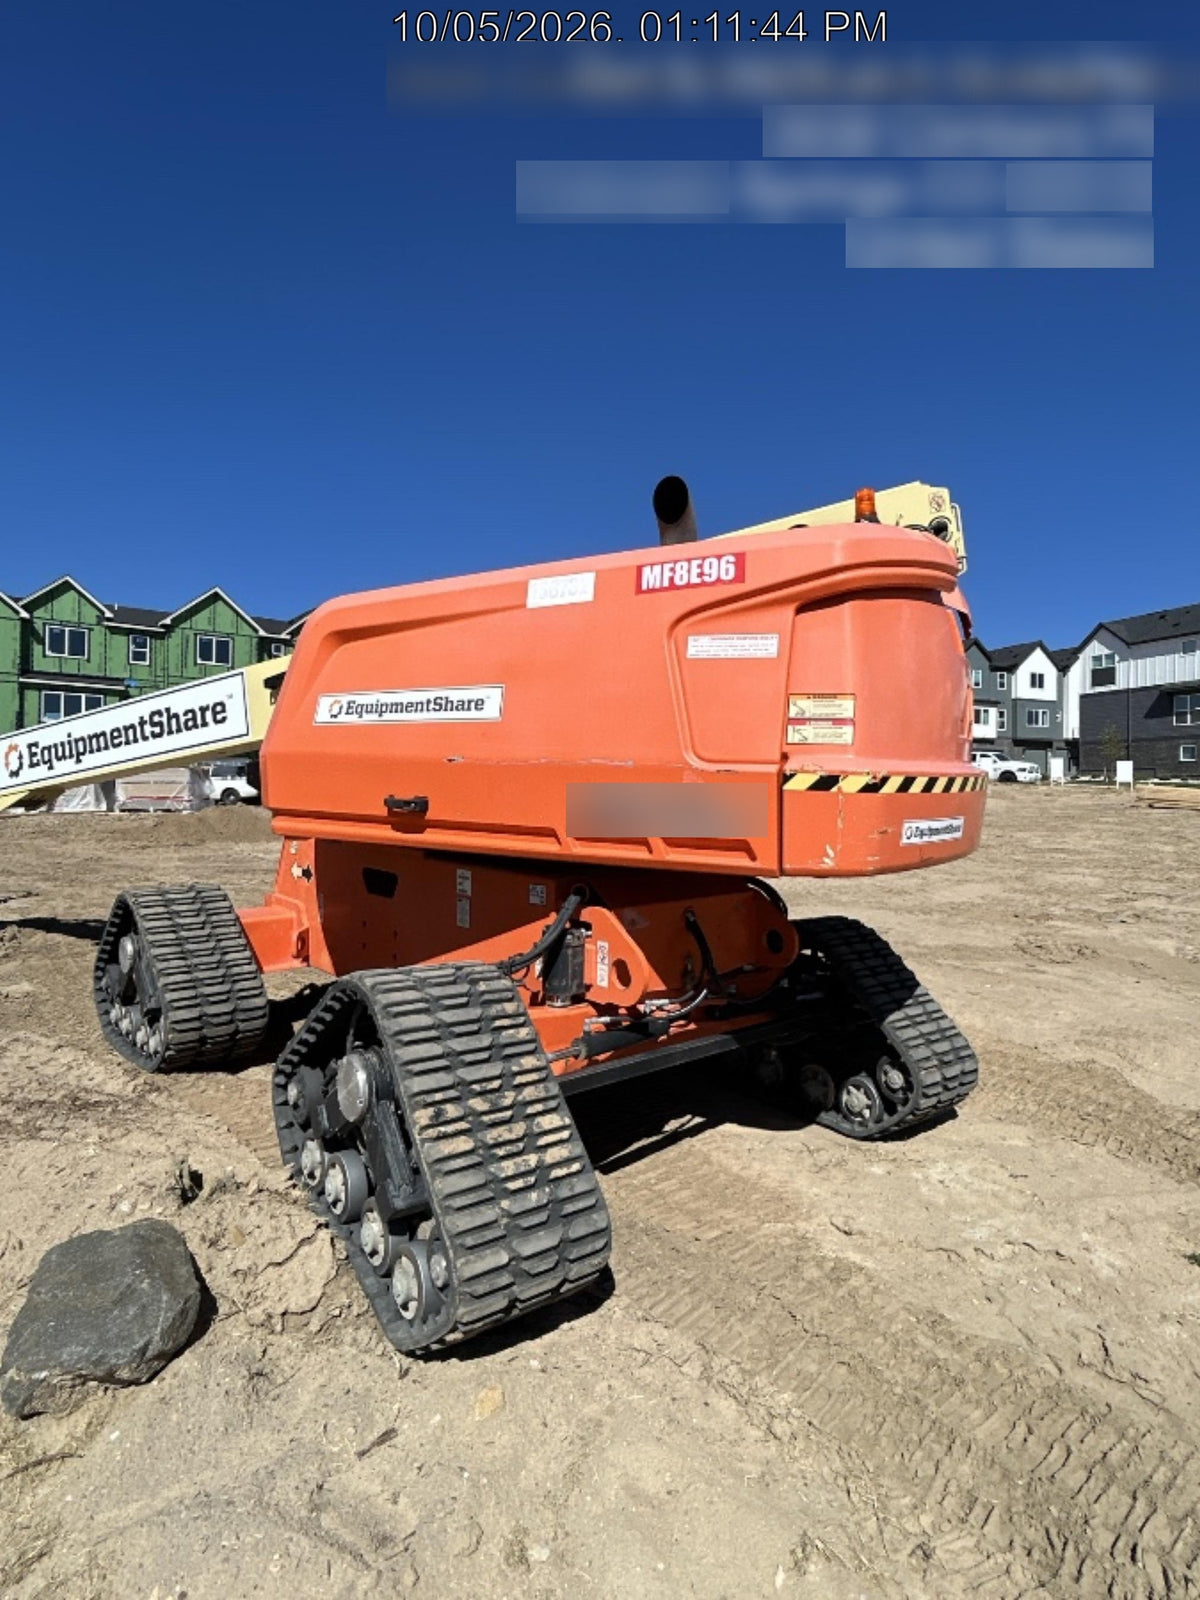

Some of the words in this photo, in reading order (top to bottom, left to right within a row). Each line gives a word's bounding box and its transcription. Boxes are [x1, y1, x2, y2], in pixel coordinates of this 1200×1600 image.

[640, 554, 737, 591] MF8E96
[344, 696, 485, 719] EquipmentShare
[26, 700, 228, 771] EquipmentShare
